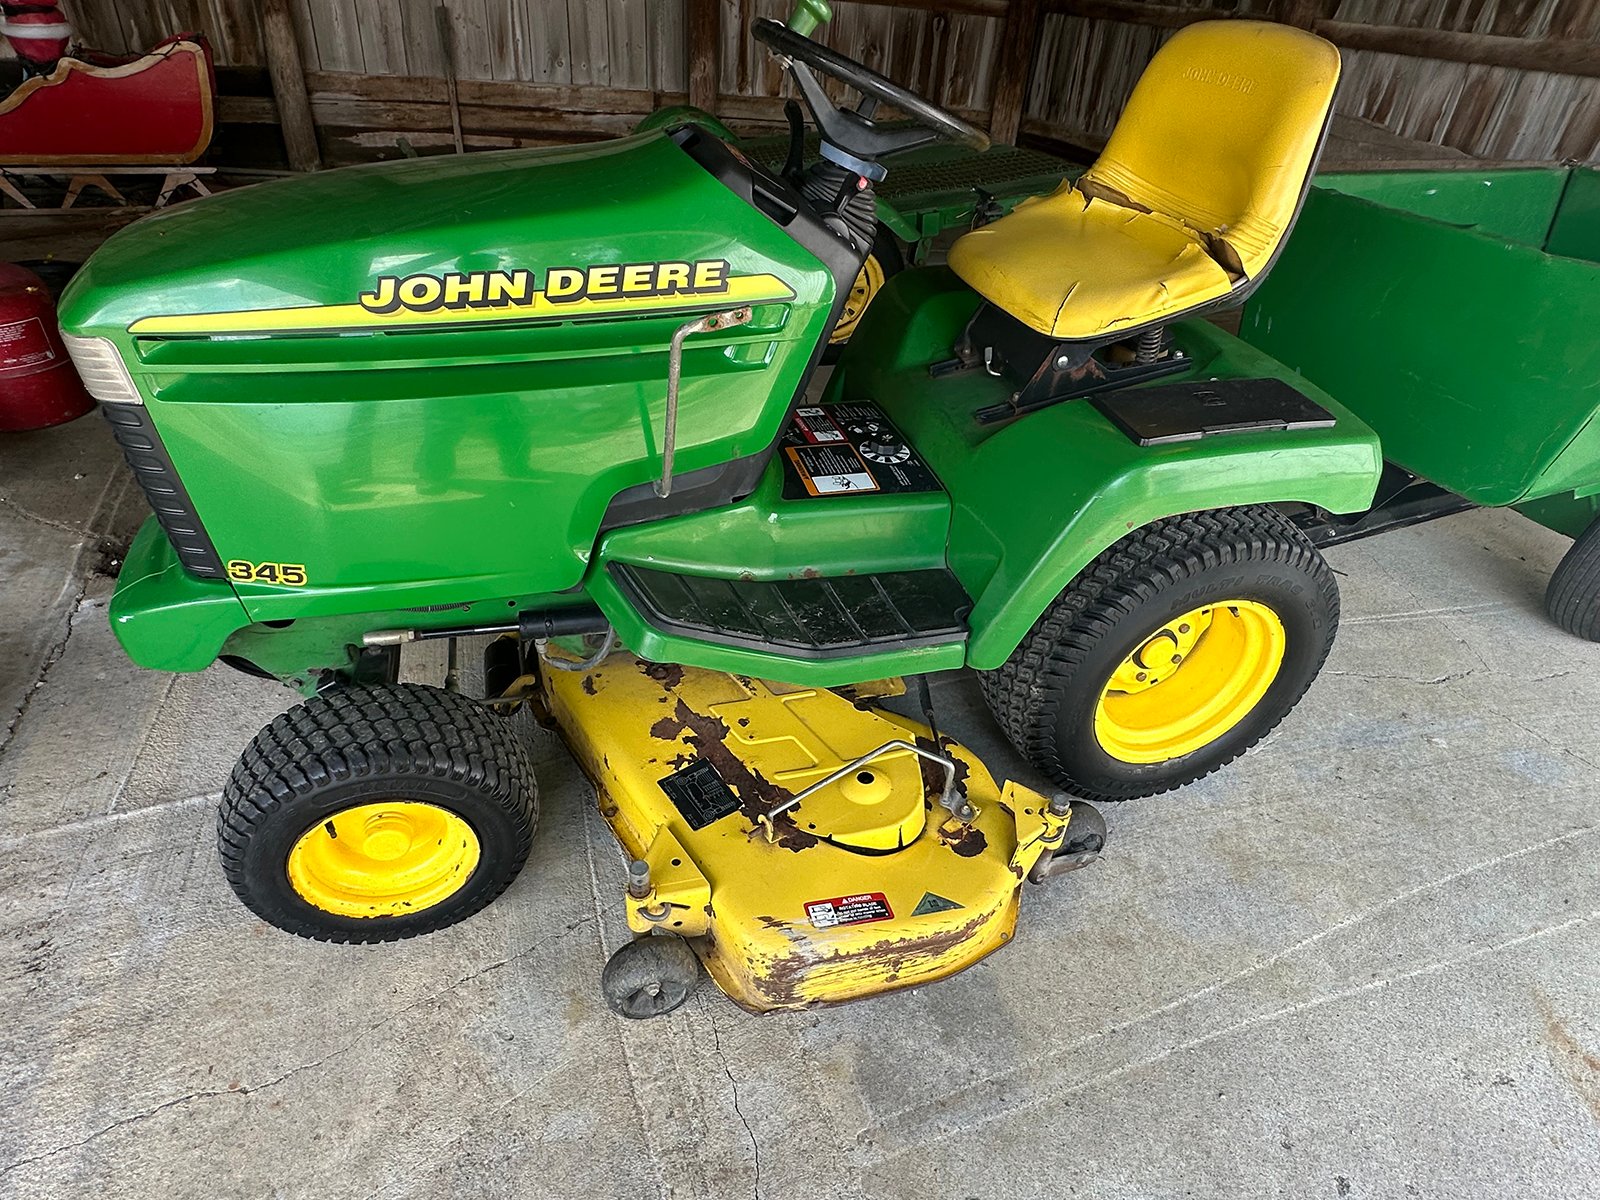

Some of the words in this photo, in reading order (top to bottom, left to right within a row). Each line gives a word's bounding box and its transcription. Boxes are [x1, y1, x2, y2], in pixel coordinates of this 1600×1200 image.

[359, 269, 536, 314] JOHN
[544, 259, 731, 304] DEERE
[228, 560, 308, 586] 345
